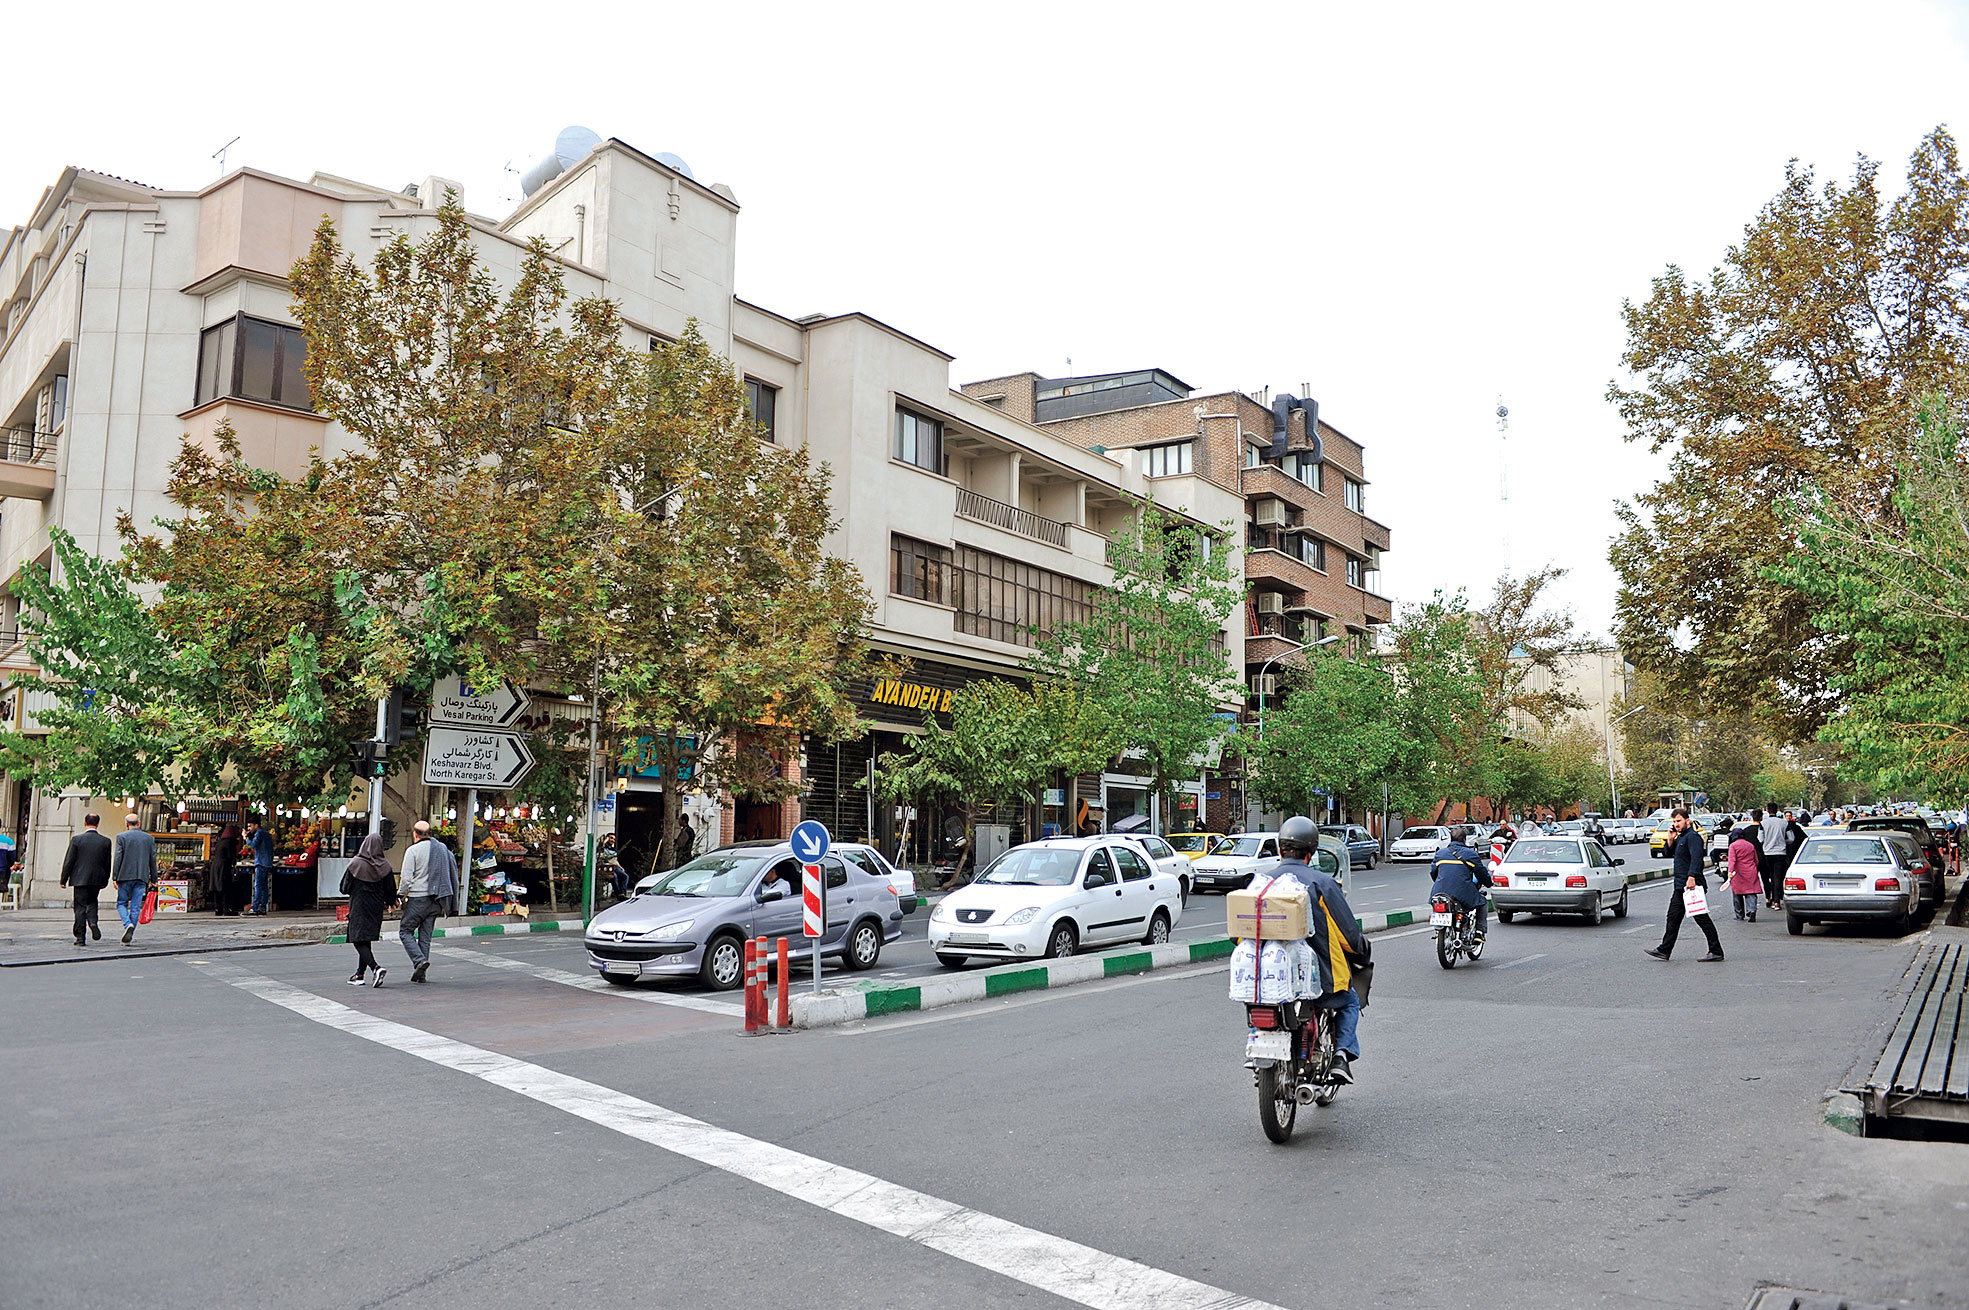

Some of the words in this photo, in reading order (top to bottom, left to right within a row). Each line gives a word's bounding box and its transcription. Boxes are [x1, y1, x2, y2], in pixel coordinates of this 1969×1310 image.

[872, 678, 940, 711] AYANDEH
[940, 689, 953, 713] B
[440, 697, 464, 709] وصال
[466, 699, 498, 714] پارکینگ
[443, 709, 464, 719] Vesal
[466, 711, 494, 723] Parking
[464, 735, 494, 746] کشاورز
[442, 748, 471, 759] شمالی
[471, 748, 493, 761] کارگر
[431, 758, 471, 769] Keshavarz
[474, 760, 493, 770] Blvd.
[430, 769, 452, 778] North
[455, 770, 485, 781] Karegar
[487, 772, 497, 781] St.
